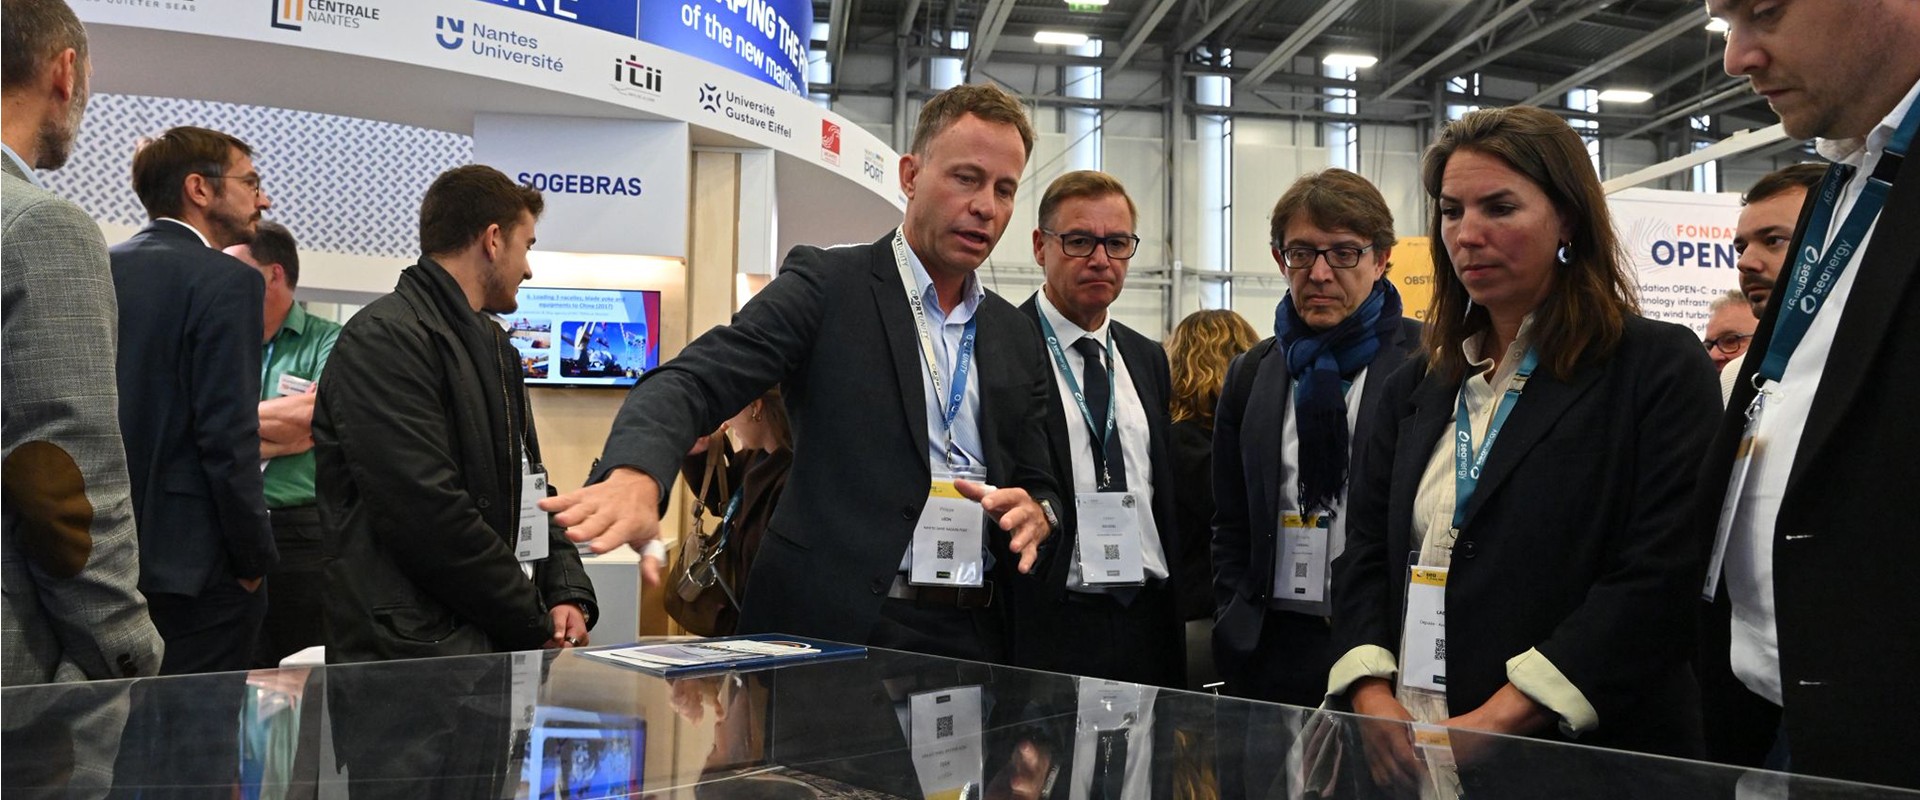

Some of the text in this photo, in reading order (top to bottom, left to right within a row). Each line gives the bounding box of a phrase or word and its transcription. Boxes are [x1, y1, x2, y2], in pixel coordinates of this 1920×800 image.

[165, 2, 196, 12] SEAS
[307, 10, 361, 29] NANTES
[308, 0, 380, 20] CENTRALE
[473, 22, 538, 50] Nantes
[681, 3, 702, 31] of
[705, 12, 733, 49] the
[735, 34, 765, 70] new
[778, 15, 800, 68] THE
[471, 40, 564, 73] Université
[725, 90, 775, 117] Université
[725, 106, 792, 139] Gustave Eiffel
[517, 172, 642, 197] SOGEBRAS
[863, 161, 884, 184] PORT
[1812, 238, 1853, 295] seanergy
[1403, 276, 1434, 286] OBST
[1663, 310, 1684, 318] wind
[1458, 443, 1468, 480] seanergy
